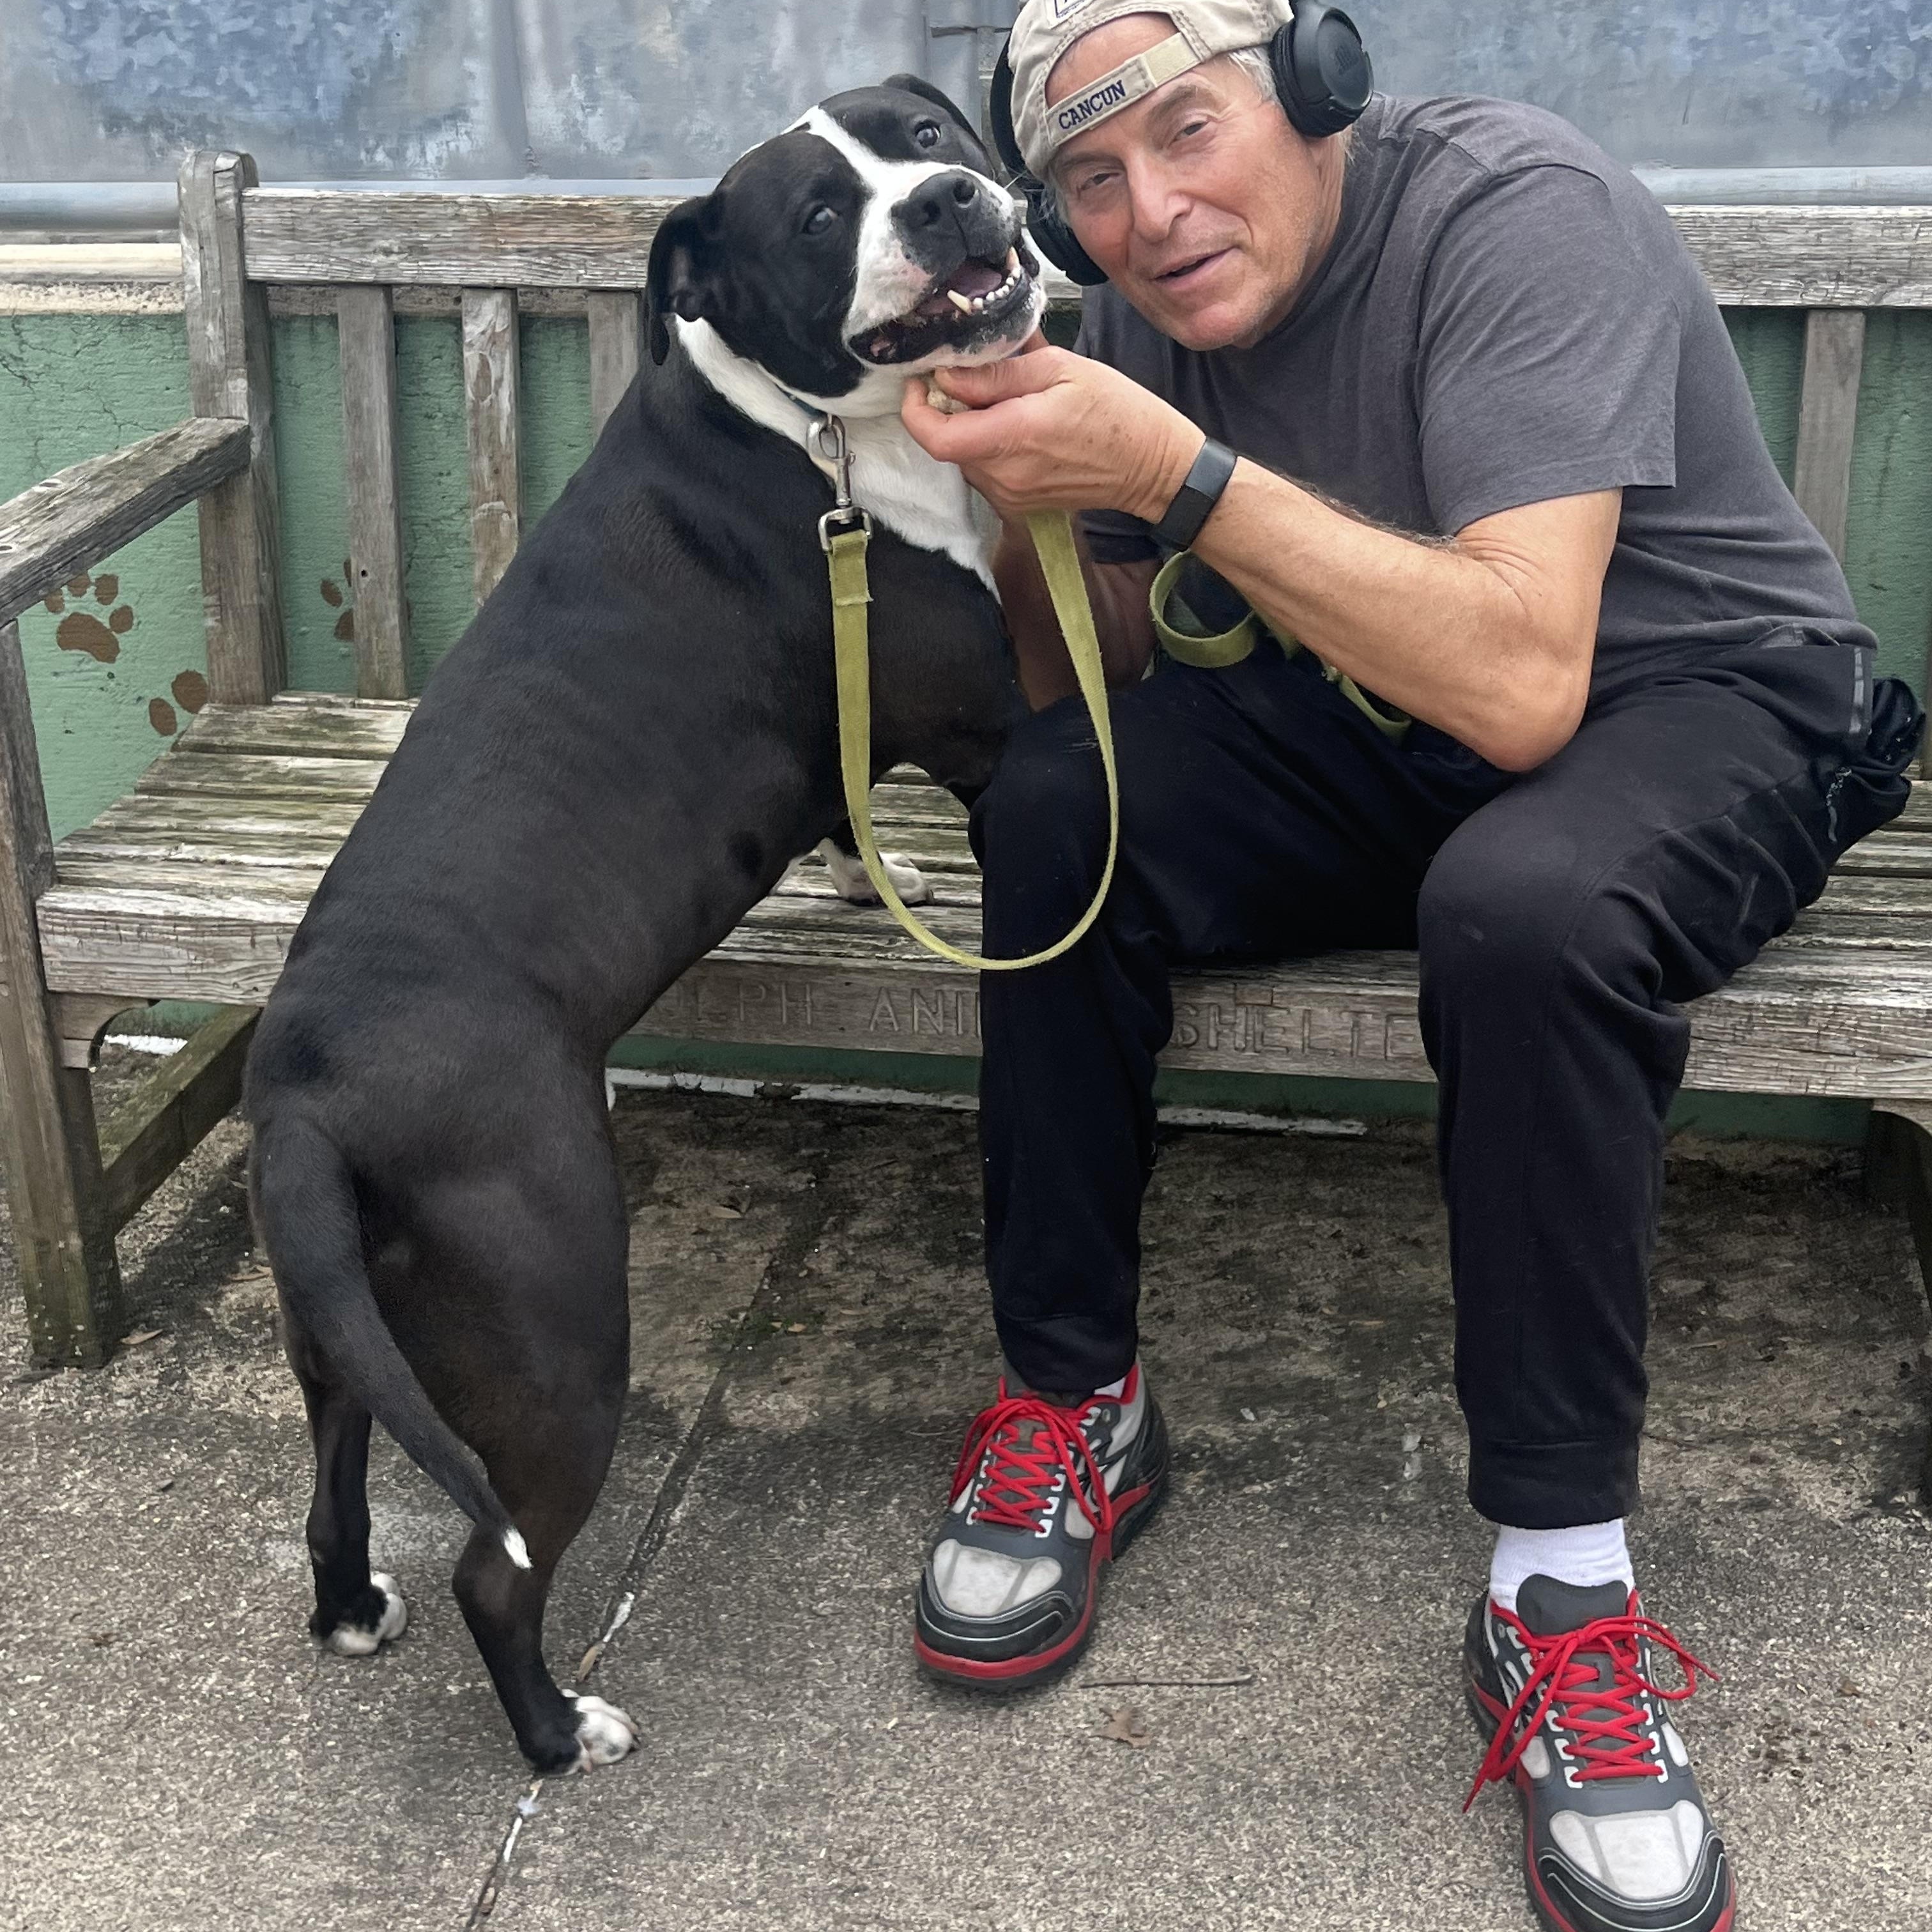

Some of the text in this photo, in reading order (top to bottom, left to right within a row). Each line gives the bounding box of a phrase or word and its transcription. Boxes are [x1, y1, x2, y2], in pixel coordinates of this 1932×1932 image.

[1058, 79, 1126, 130] CANCUN
[870, 986, 982, 1038] ANI
[1170, 1003, 1421, 1060] SHELTE
